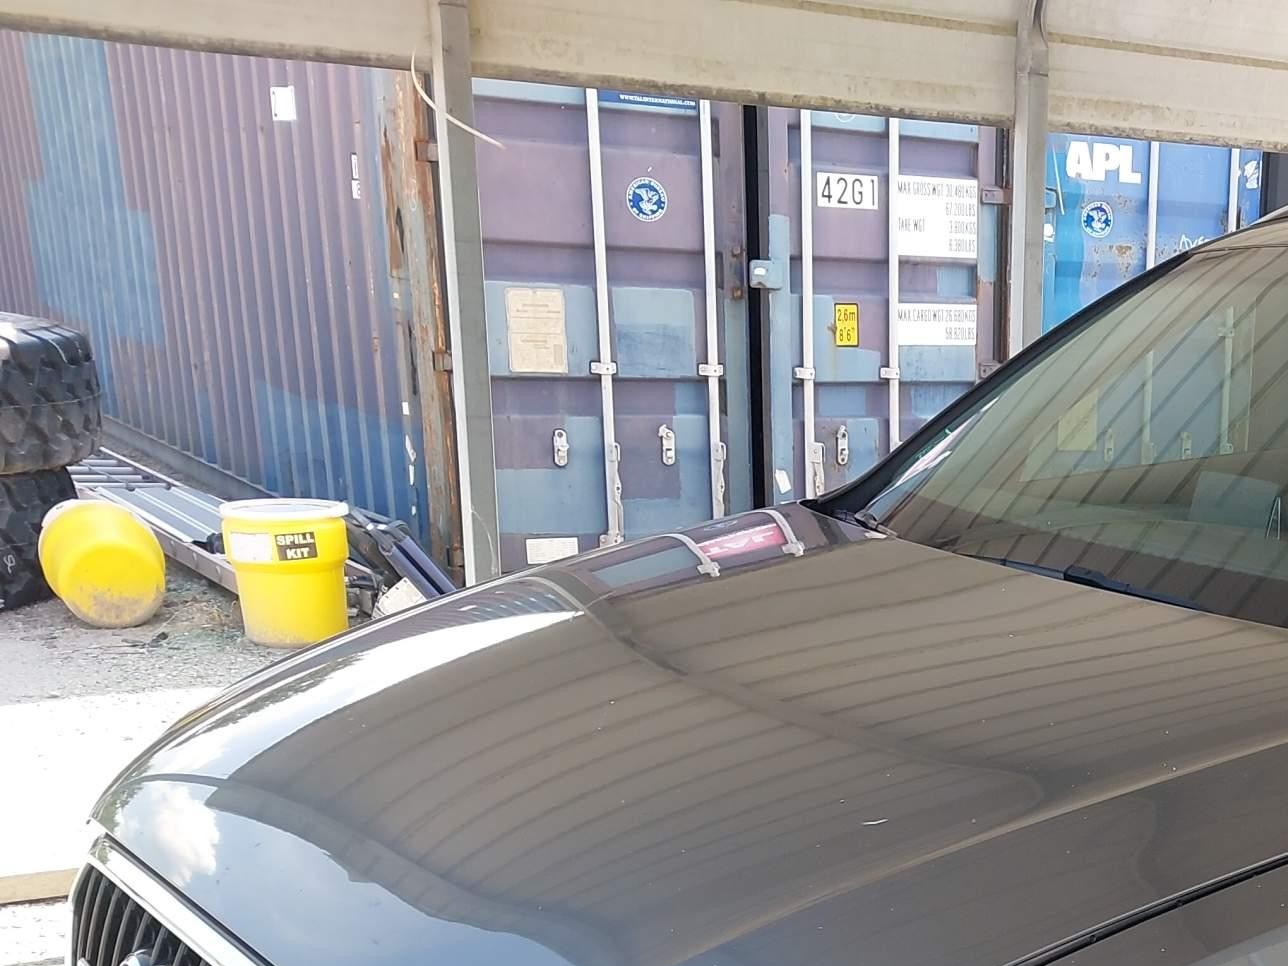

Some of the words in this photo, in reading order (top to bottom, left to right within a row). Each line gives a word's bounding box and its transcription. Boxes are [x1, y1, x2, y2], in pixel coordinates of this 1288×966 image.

[1066, 141, 1141, 184] APL
[276, 533, 314, 545] SPILL
[286, 547, 310, 560] KIT
